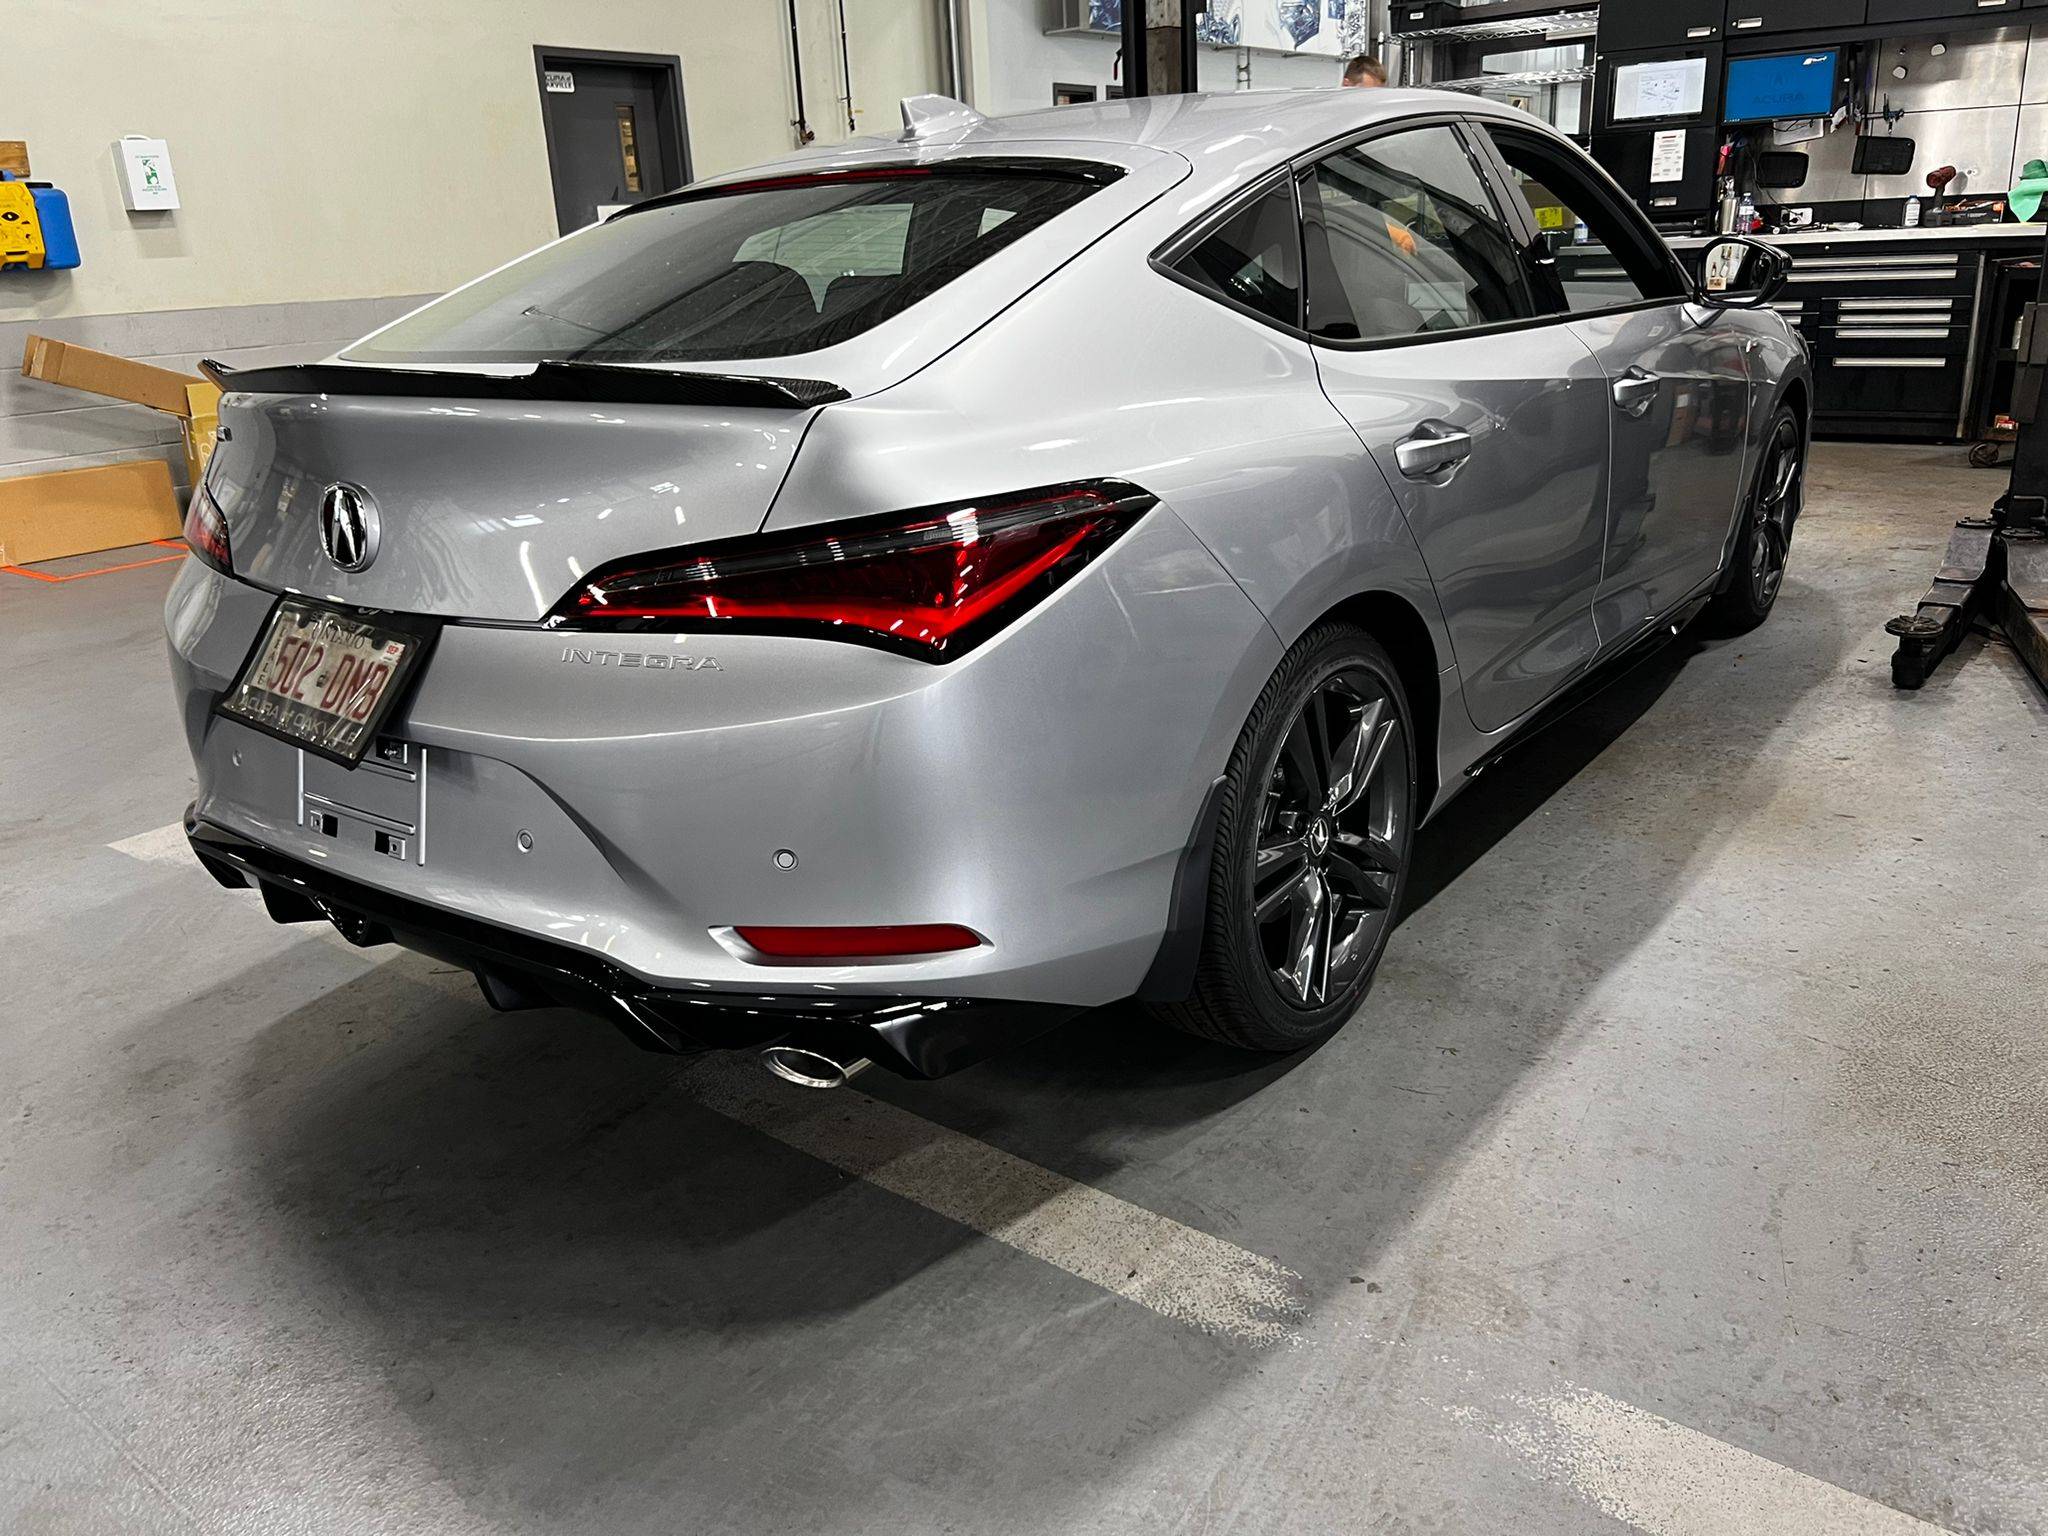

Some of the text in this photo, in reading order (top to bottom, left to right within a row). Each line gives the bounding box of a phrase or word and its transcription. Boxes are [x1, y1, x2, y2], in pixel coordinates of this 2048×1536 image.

[1752, 91, 1806, 105] ACURA
[269, 634, 325, 700] 502
[561, 647, 724, 672] INTEGRA
